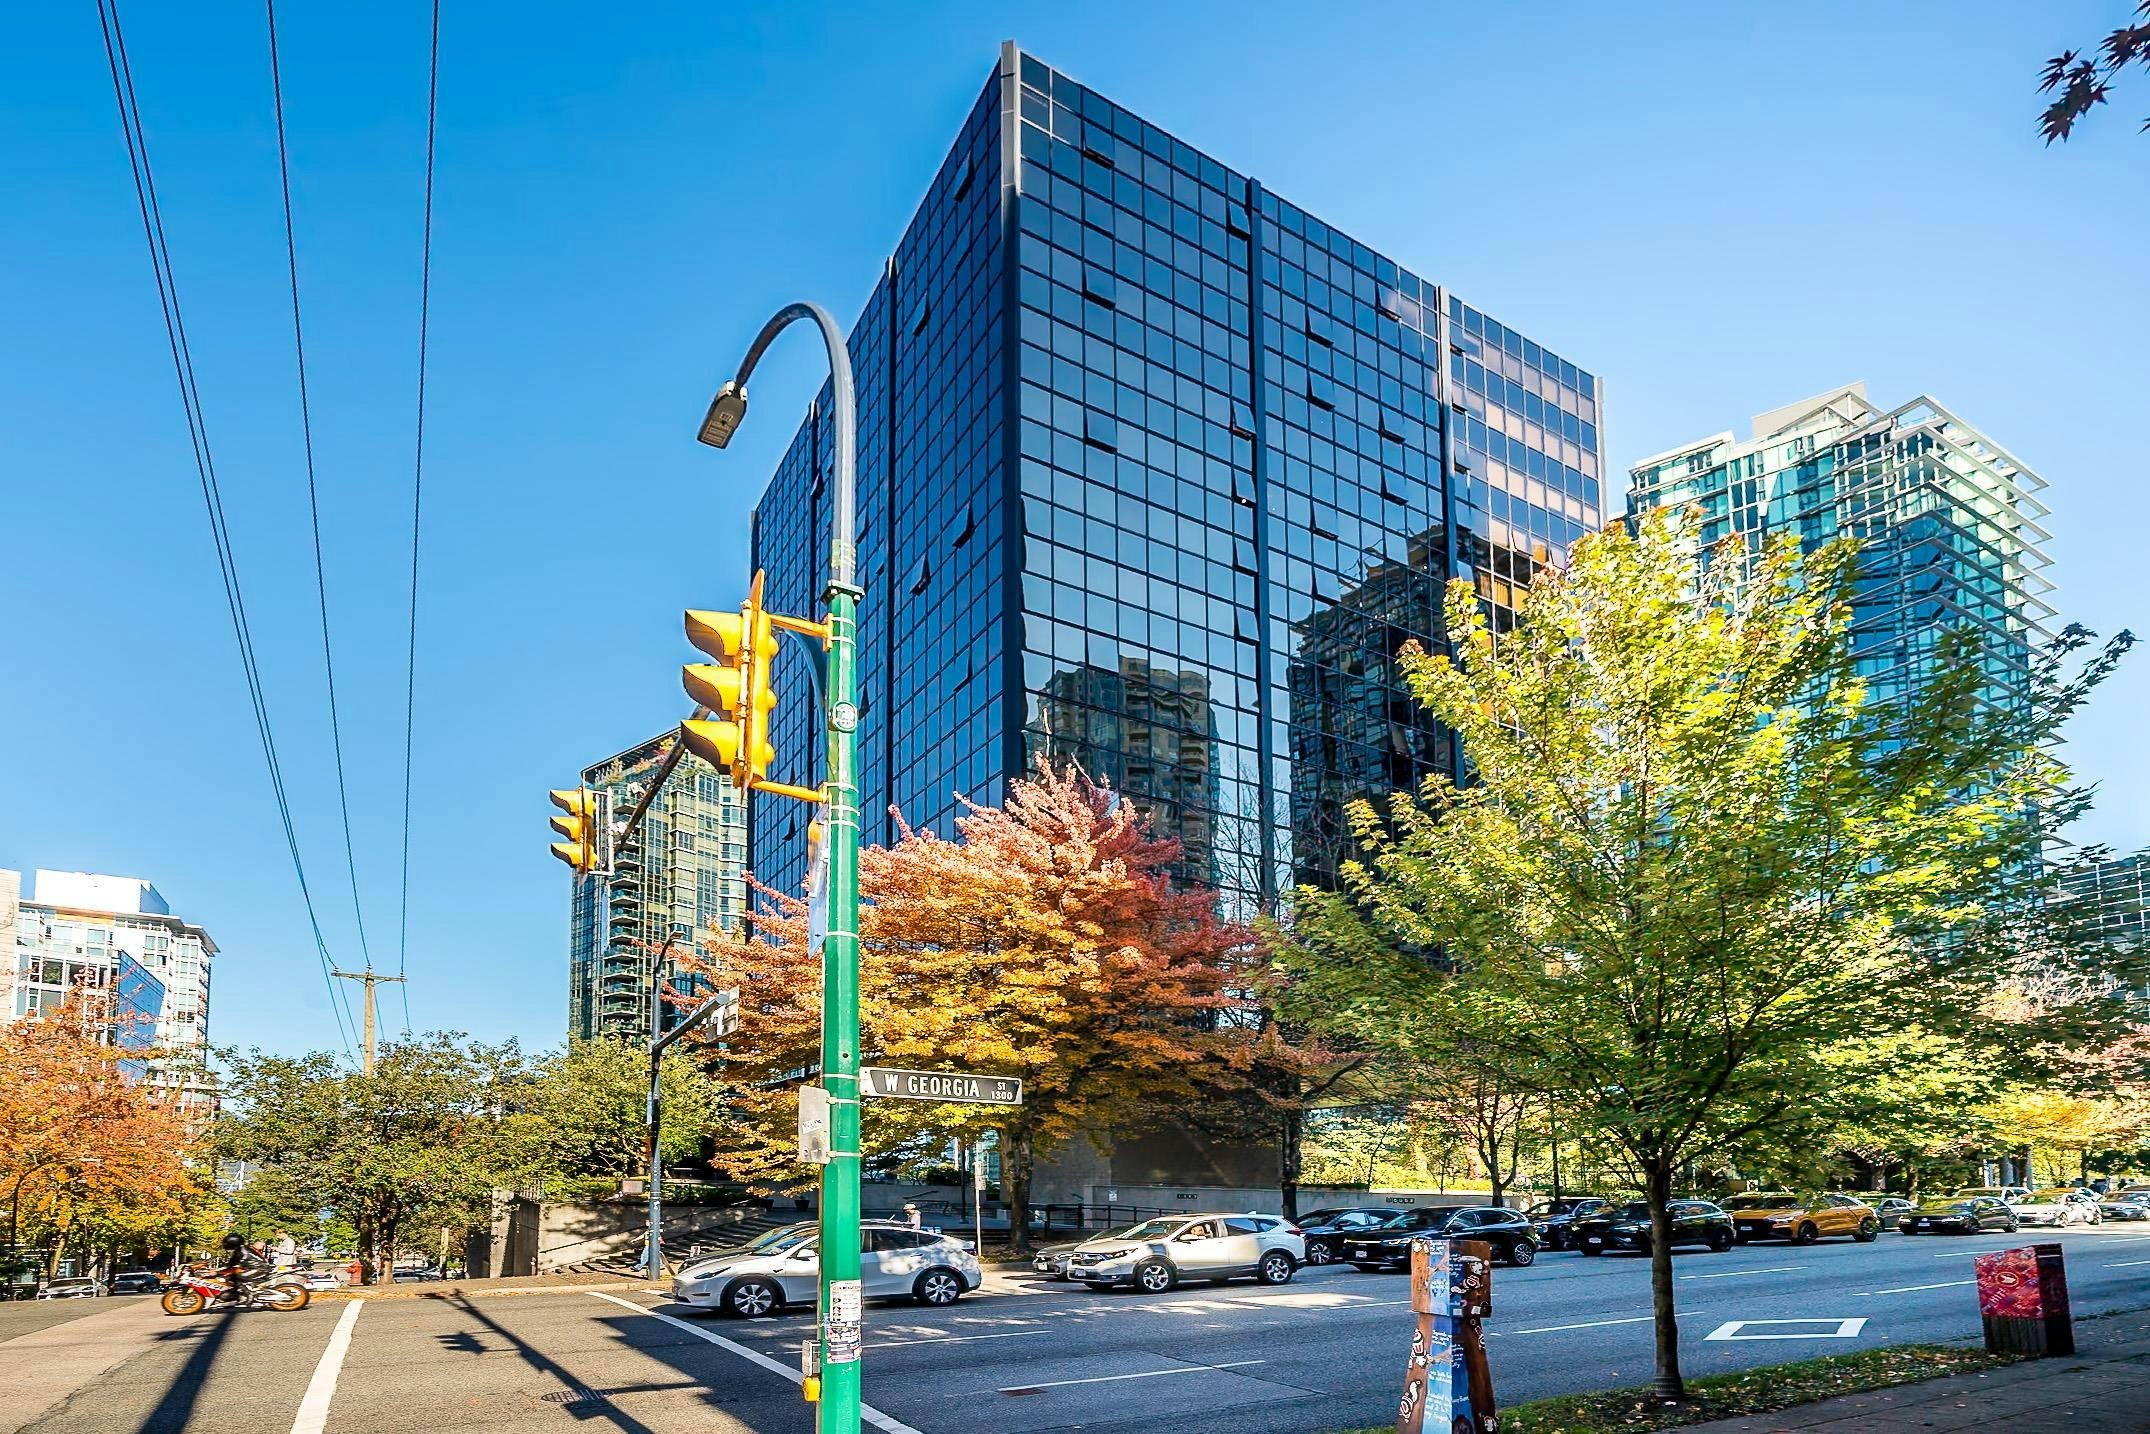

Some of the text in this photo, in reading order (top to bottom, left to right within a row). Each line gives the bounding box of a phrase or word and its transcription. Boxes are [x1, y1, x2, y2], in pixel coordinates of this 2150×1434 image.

[884, 1073, 1007, 1098] W GEORGIA ST
[991, 1090, 1013, 1101] 1300
